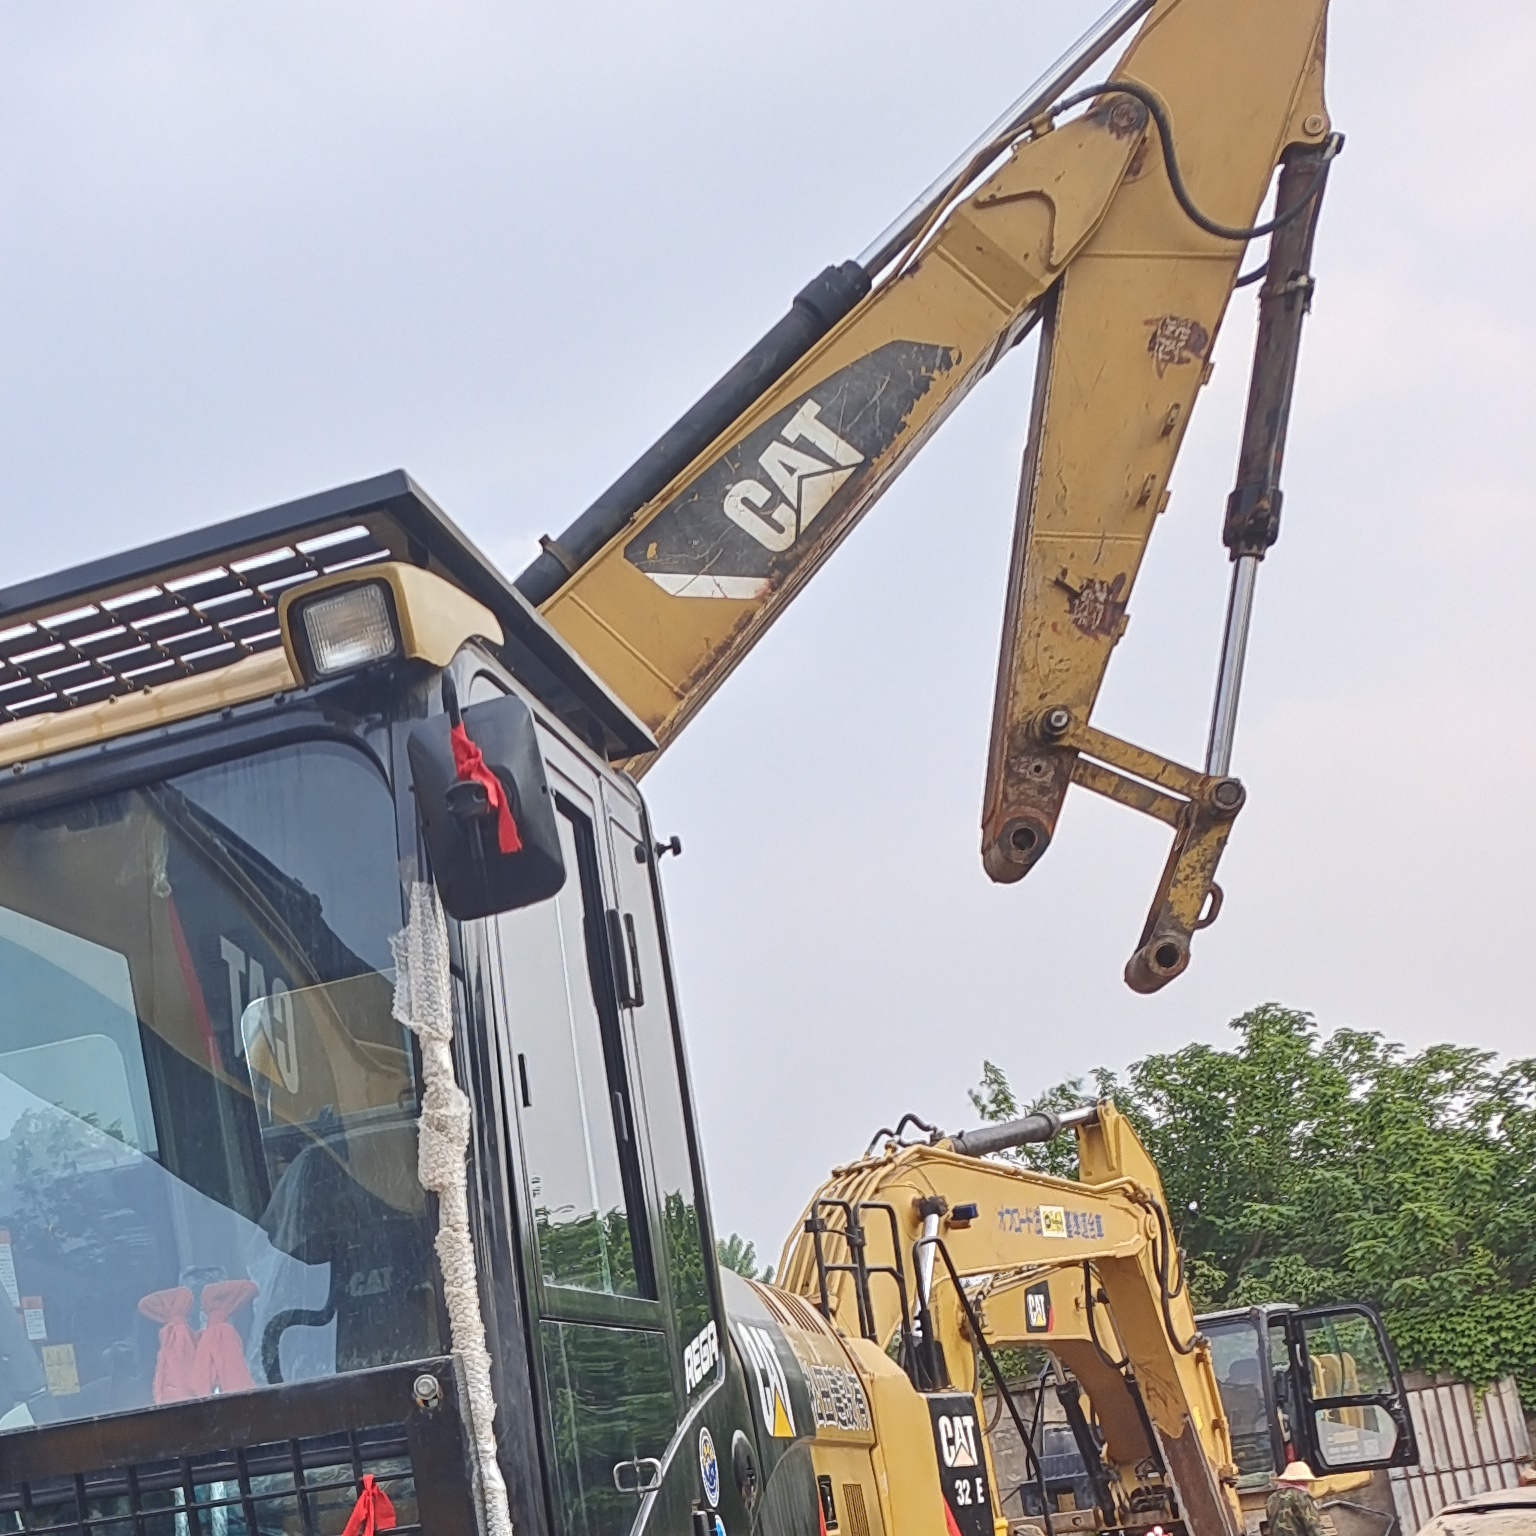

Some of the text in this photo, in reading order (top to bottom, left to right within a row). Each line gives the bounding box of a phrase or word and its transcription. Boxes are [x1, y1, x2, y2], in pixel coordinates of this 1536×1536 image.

[723, 397, 865, 553] CAT
[349, 1266, 394, 1297] CAT
[1026, 1293, 1047, 1327] CAT
[737, 1321, 797, 1438] CAT
[938, 1415, 978, 1468] CAT
